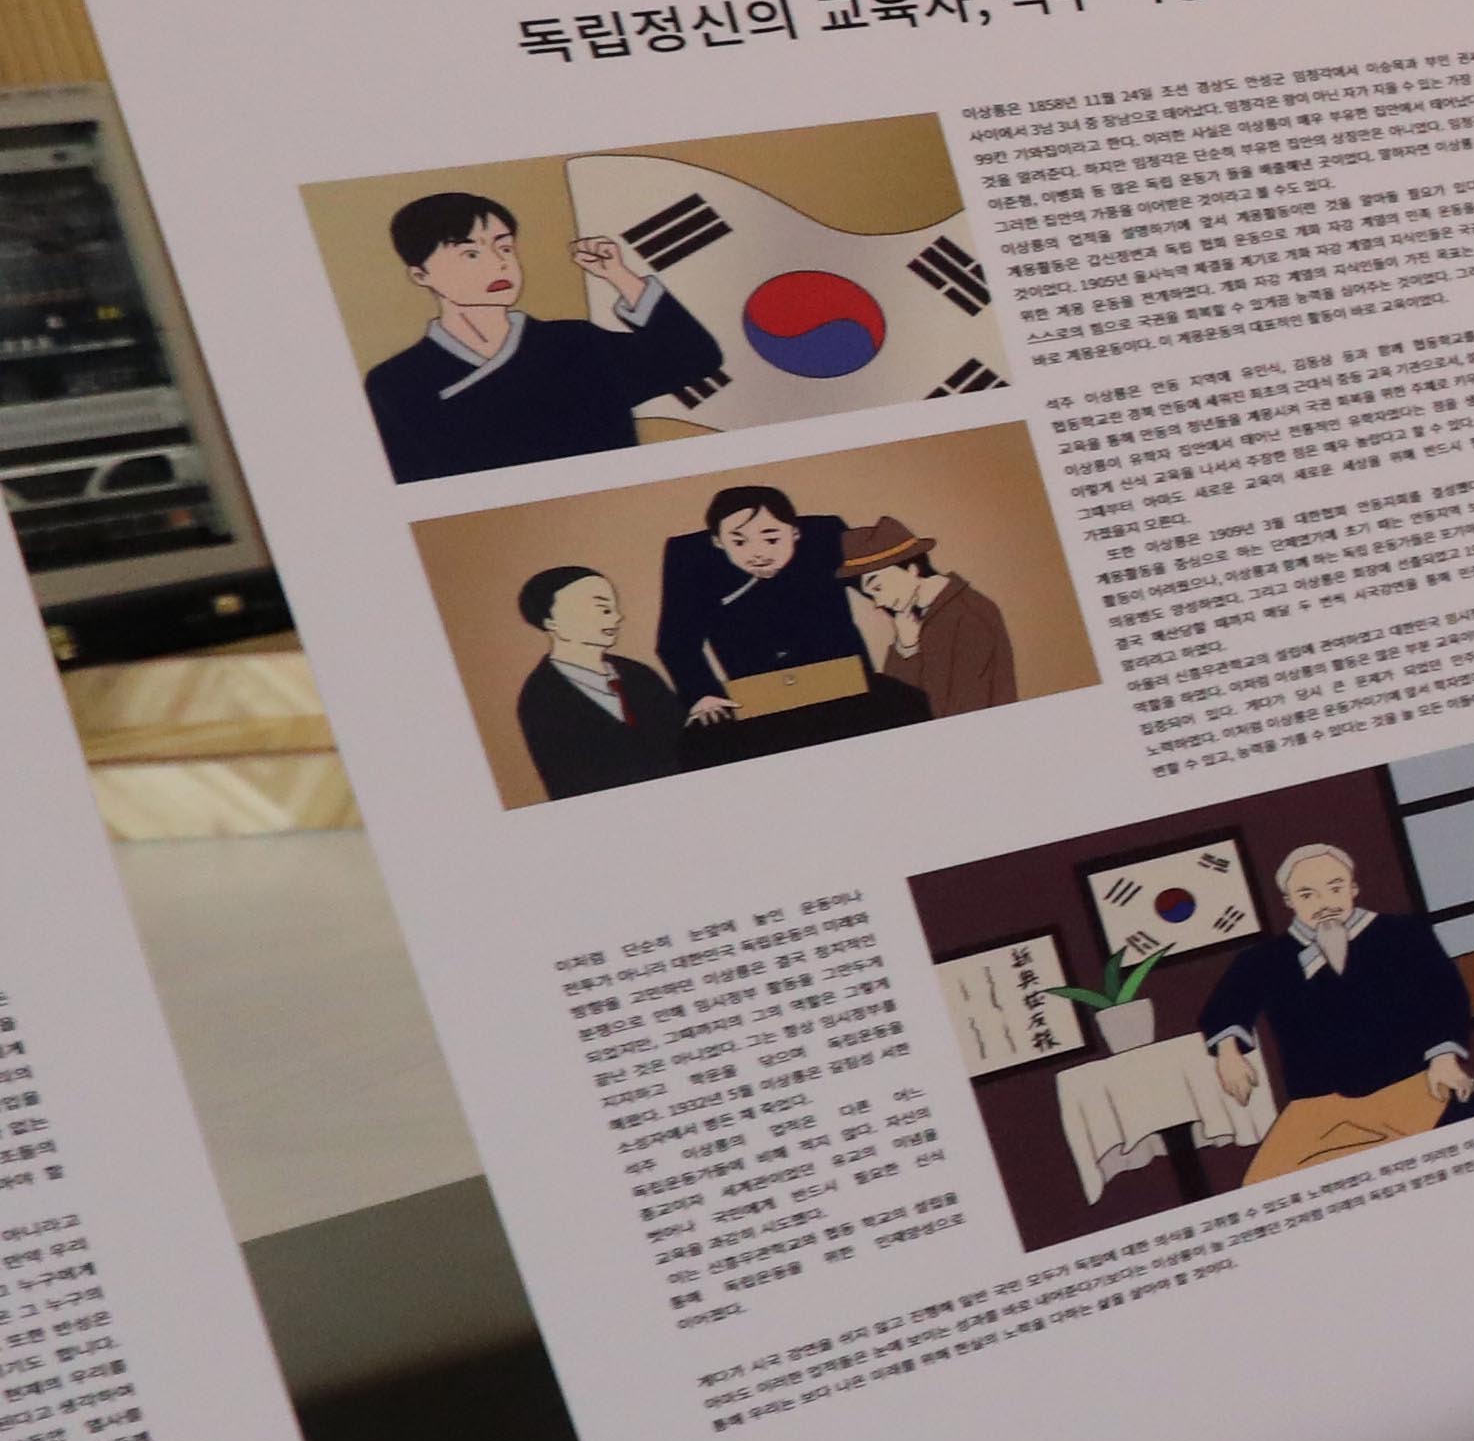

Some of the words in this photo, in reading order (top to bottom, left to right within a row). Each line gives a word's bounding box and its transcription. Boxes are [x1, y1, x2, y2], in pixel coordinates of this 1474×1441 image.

[962, 102, 1022, 120] 이상룡은
[1027, 96, 1078, 113] 1858년
[1083, 91, 1116, 107] 11월
[1120, 87, 1153, 103] 24일
[1160, 83, 1189, 98] 조선
[969, 125, 1029, 143] 사이에서
[1101, 109, 1161, 128] 장남으로
[1403, 81, 1414, 91] 수
[1143, 129, 1186, 145] 이러한
[981, 173, 1012, 189] 것을
[1106, 545, 1136, 561] 또한
